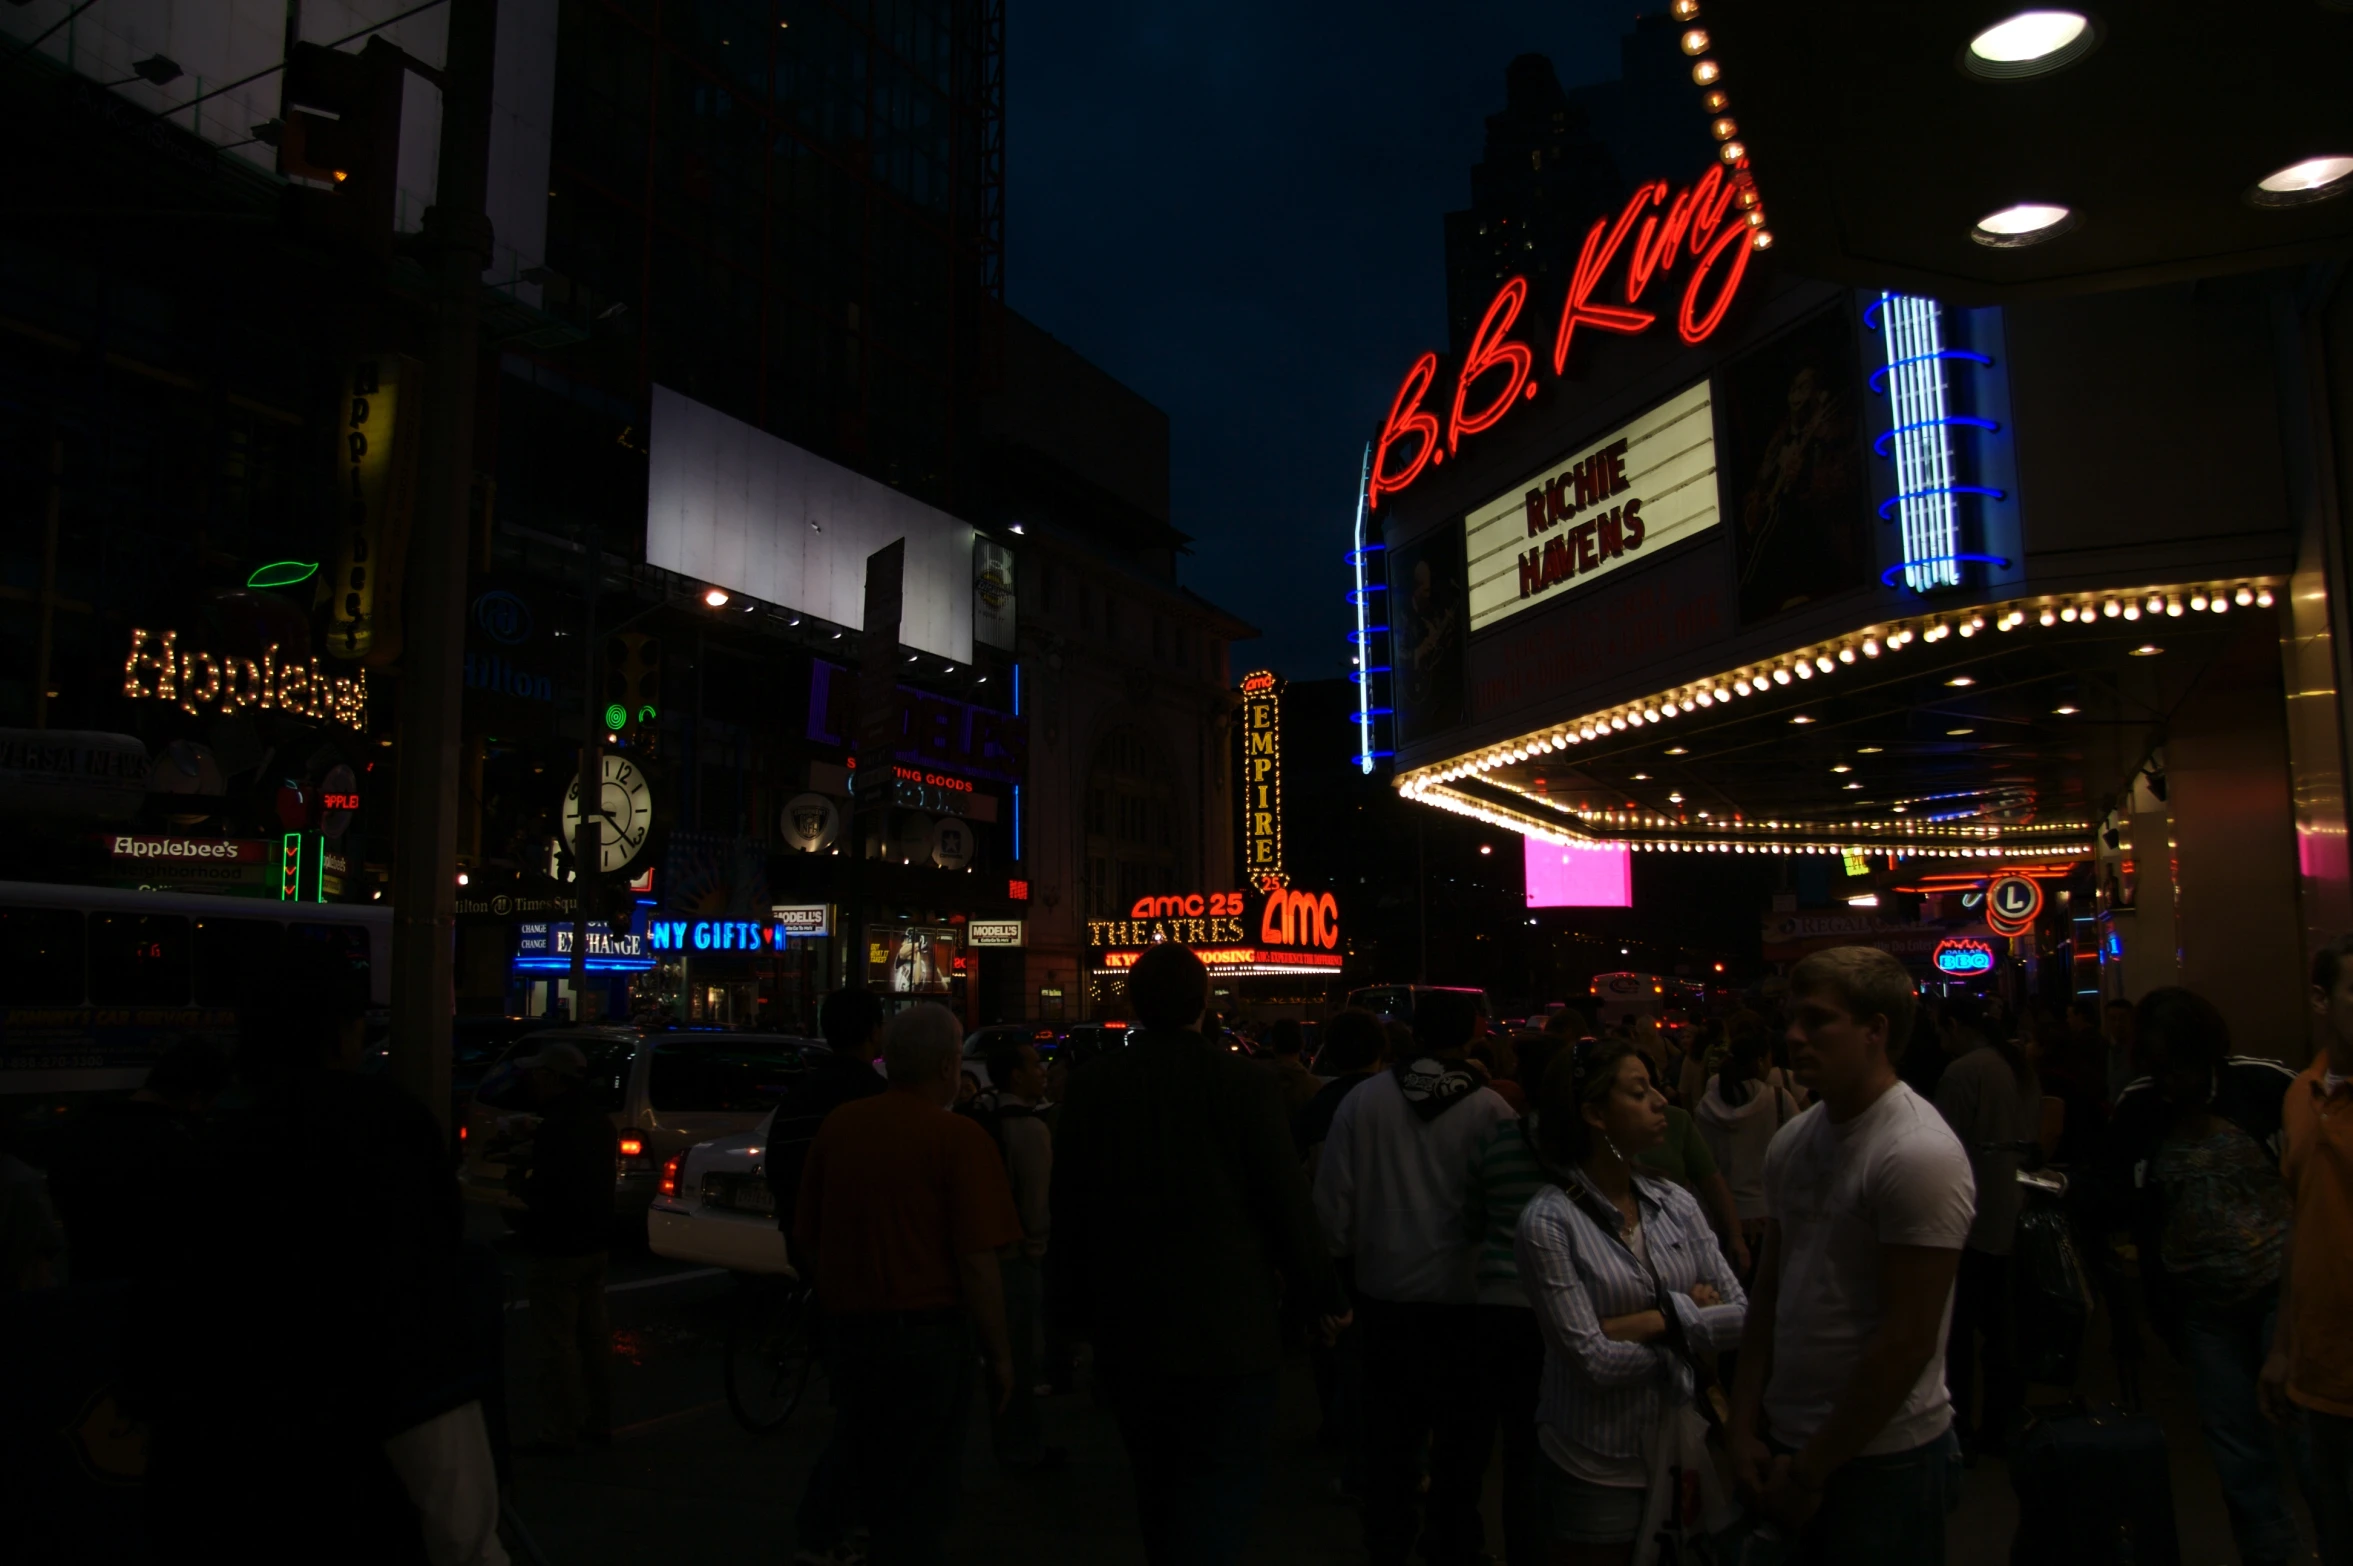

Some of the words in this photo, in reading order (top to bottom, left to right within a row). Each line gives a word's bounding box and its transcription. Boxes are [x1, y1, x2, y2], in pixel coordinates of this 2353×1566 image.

[1554, 157, 1762, 377] King
[1525, 437, 1631, 538] RICHIE
[1518, 498, 1646, 600] HAVENS
[925, 774, 974, 793] GOODS
[1250, 704, 1274, 863] EMPIRE
[615, 761, 632, 786] 12
[633, 826, 645, 845] 3
[113, 836, 239, 859] Applebee's
[1262, 876, 1280, 891] 25
[515, 897, 552, 912] Times
[554, 896, 578, 914] Squ
[1209, 893, 1244, 916] 25
[521, 924, 547, 934] CHANGE
[652, 921, 688, 950] NY
[694, 921, 762, 950] GIFTS
[973, 926, 1018, 936] MODELL'S
[1088, 917, 1245, 946] THEATRES
[1801, 915, 1869, 933] REGAL
[521, 939, 547, 949] CHANGE
[556, 931, 642, 956] EXHANGE
[1939, 954, 1990, 970] BBQ
[95, 1009, 131, 1027] CAR
